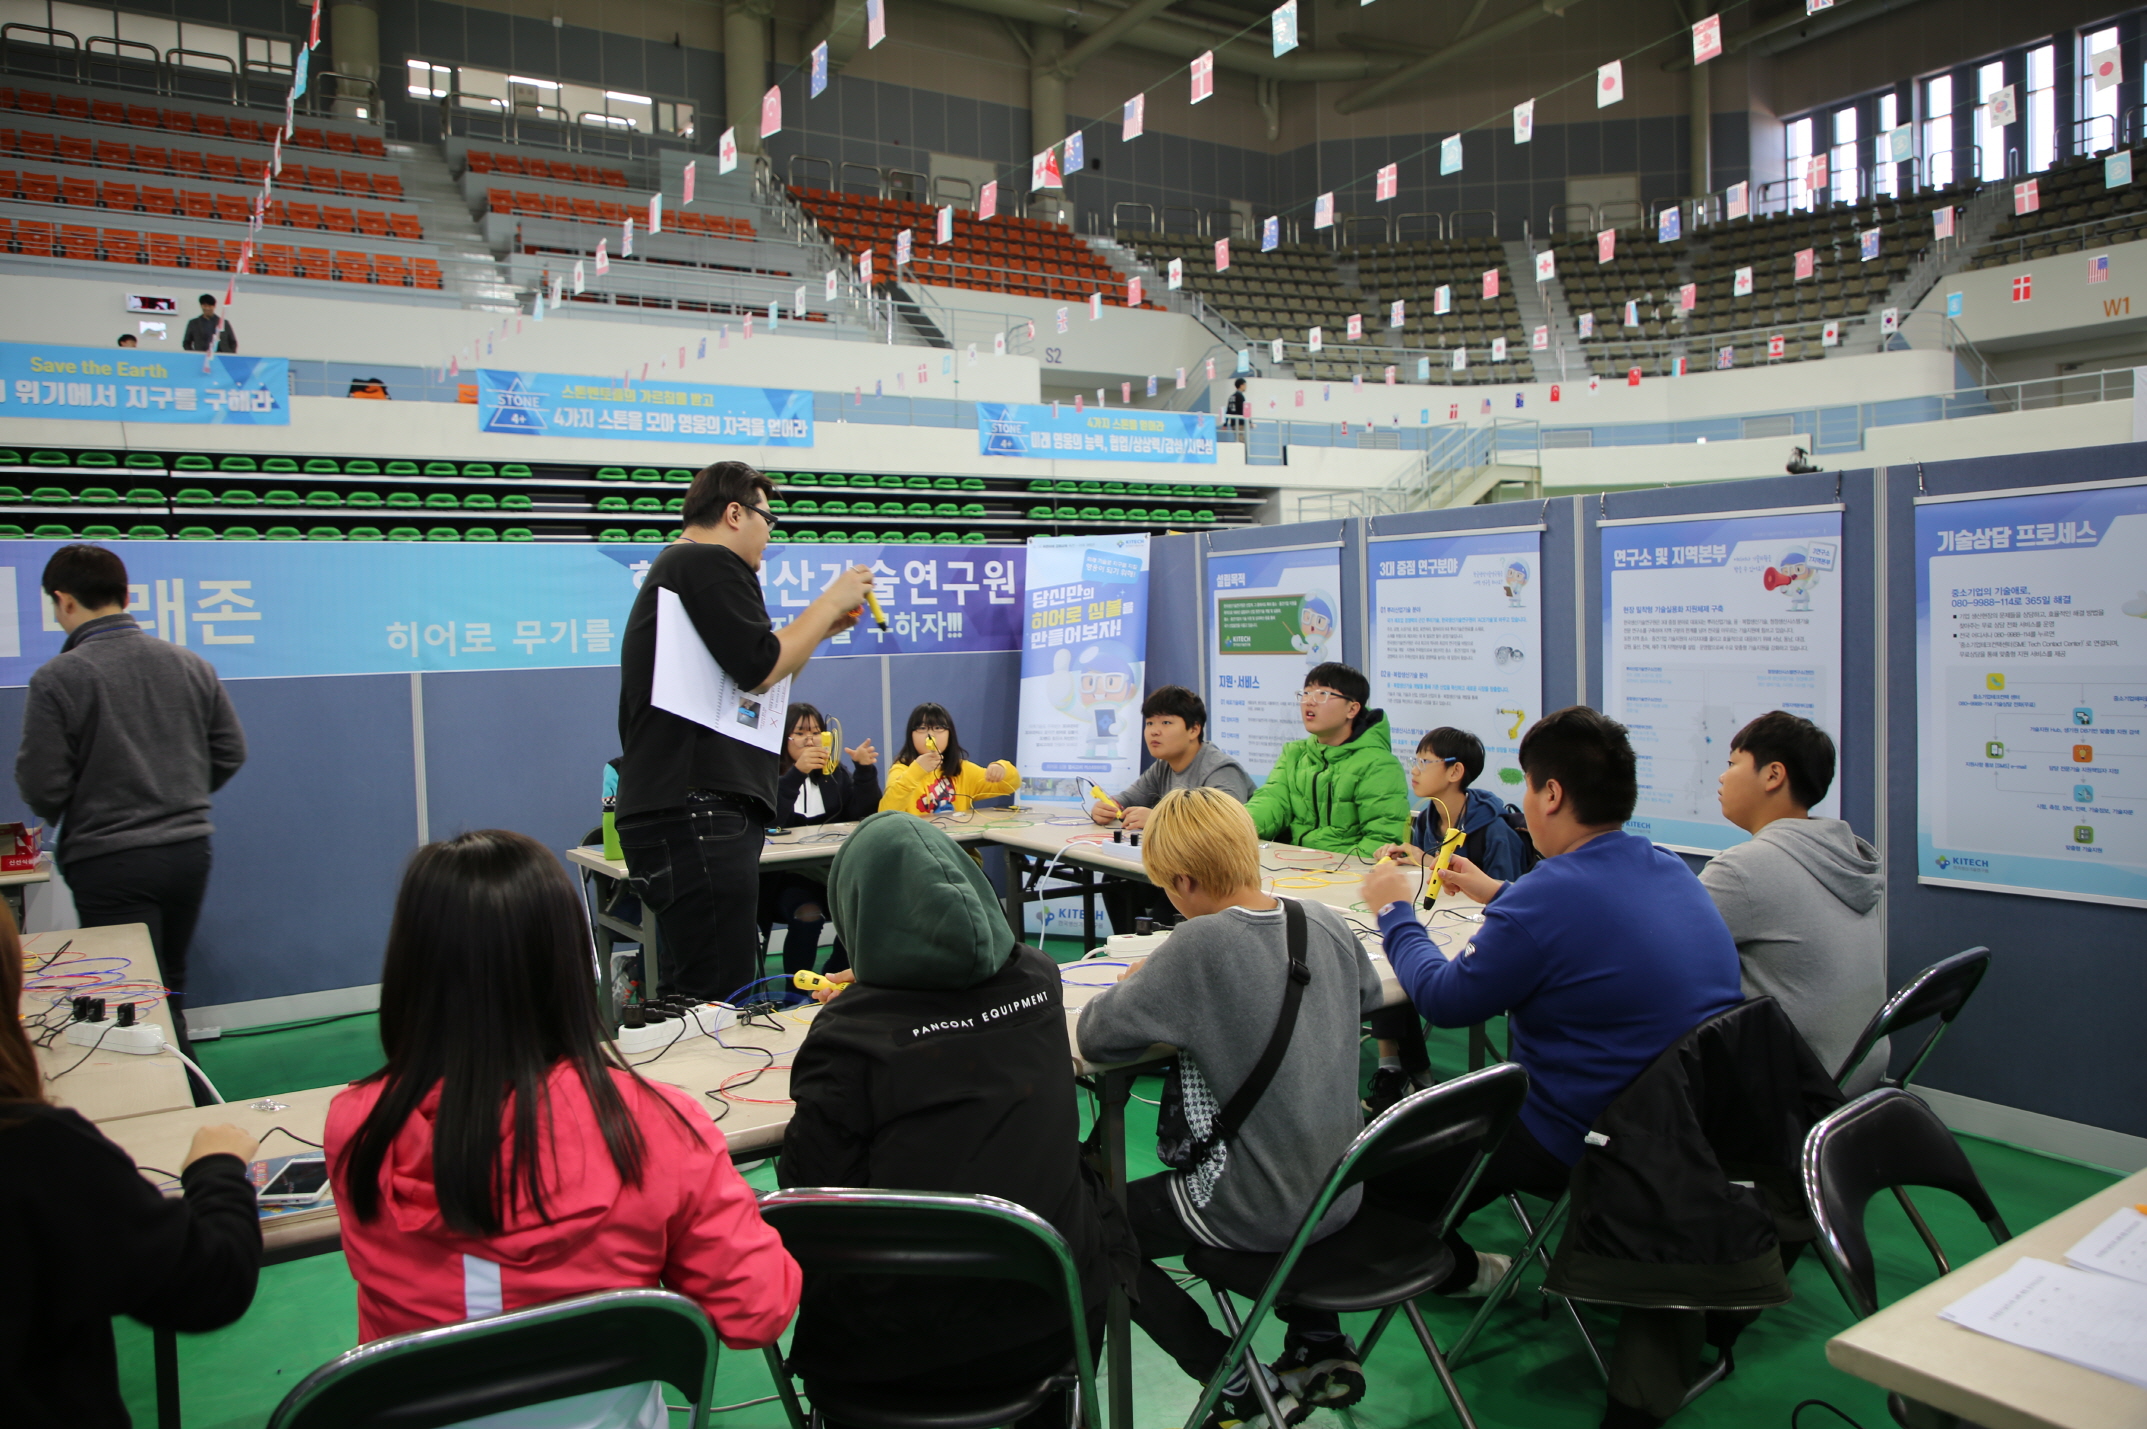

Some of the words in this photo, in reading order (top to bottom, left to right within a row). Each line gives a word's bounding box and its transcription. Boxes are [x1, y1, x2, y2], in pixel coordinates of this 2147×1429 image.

[2103, 296, 2130, 317] W1
[1046, 347, 1062, 364] S2
[30, 357, 77, 374] Save
[82, 360, 112, 376] the
[117, 362, 168, 379] Earth
[15, 380, 116, 408] 위기에서
[125, 385, 197, 411] 지구를
[204, 388, 275, 412] 구해라
[498, 394, 540, 408] STONE
[640, 390, 687, 406] 가르침을
[690, 392, 714, 407] 받고
[510, 413, 526, 424] 4+
[554, 407, 594, 428] 4가지
[598, 410, 643, 430] 스톤을
[646, 412, 676, 432] 모아
[678, 414, 720, 434] 영웅의
[723, 416, 765, 437] 자격을
[767, 418, 808, 438] 얻어라
[1087, 416, 1110, 429] 4가지
[1112, 418, 1138, 430] 스톤을
[992, 423, 1022, 434] STONE
[1000, 439, 1012, 448] 4+
[1030, 431, 1050, 448] 미래
[1053, 432, 1082, 450] 영웅의
[1938, 526, 2012, 552] 기술상담
[2016, 520, 2098, 546] 프로세스
[1614, 548, 1652, 568] 연구소
[1656, 547, 1668, 566] 및
[1672, 544, 1726, 564] 지역본부
[1086, 563, 1105, 572] 영웅이
[1380, 561, 1394, 576] 3대
[1397, 560, 1415, 576] 중점
[1418, 558, 1458, 574] 연구분야
[1216, 572, 1246, 588] 설립목적
[1032, 584, 1094, 608] 당신만의
[1952, 587, 1992, 597] 중소기업의
[1623, 606, 1634, 614] 현장
[1636, 606, 1652, 614] 밀착형
[1655, 605, 1683, 614] 기술실용화
[1685, 605, 1709, 613] 지원체제
[1711, 605, 1723, 613] 구축
[1951, 597, 2022, 608] 080-9988-114로
[2024, 596, 2050, 606] 365일
[2053, 595, 2071, 605] 해결
[1032, 606, 1082, 629] 히어로
[1088, 598, 1134, 620] 심볼을
[386, 619, 498, 658] 히어로
[512, 618, 615, 655] 무기를
[1030, 618, 1122, 650] 만들어보자!
[1626, 821, 1650, 829] KITECH
[1953, 857, 1988, 867] KITECH
[1058, 908, 1104, 920] KITEH
[912, 1018, 974, 1036] PANCOAT
[982, 991, 1048, 1022] EQUIPMENT
